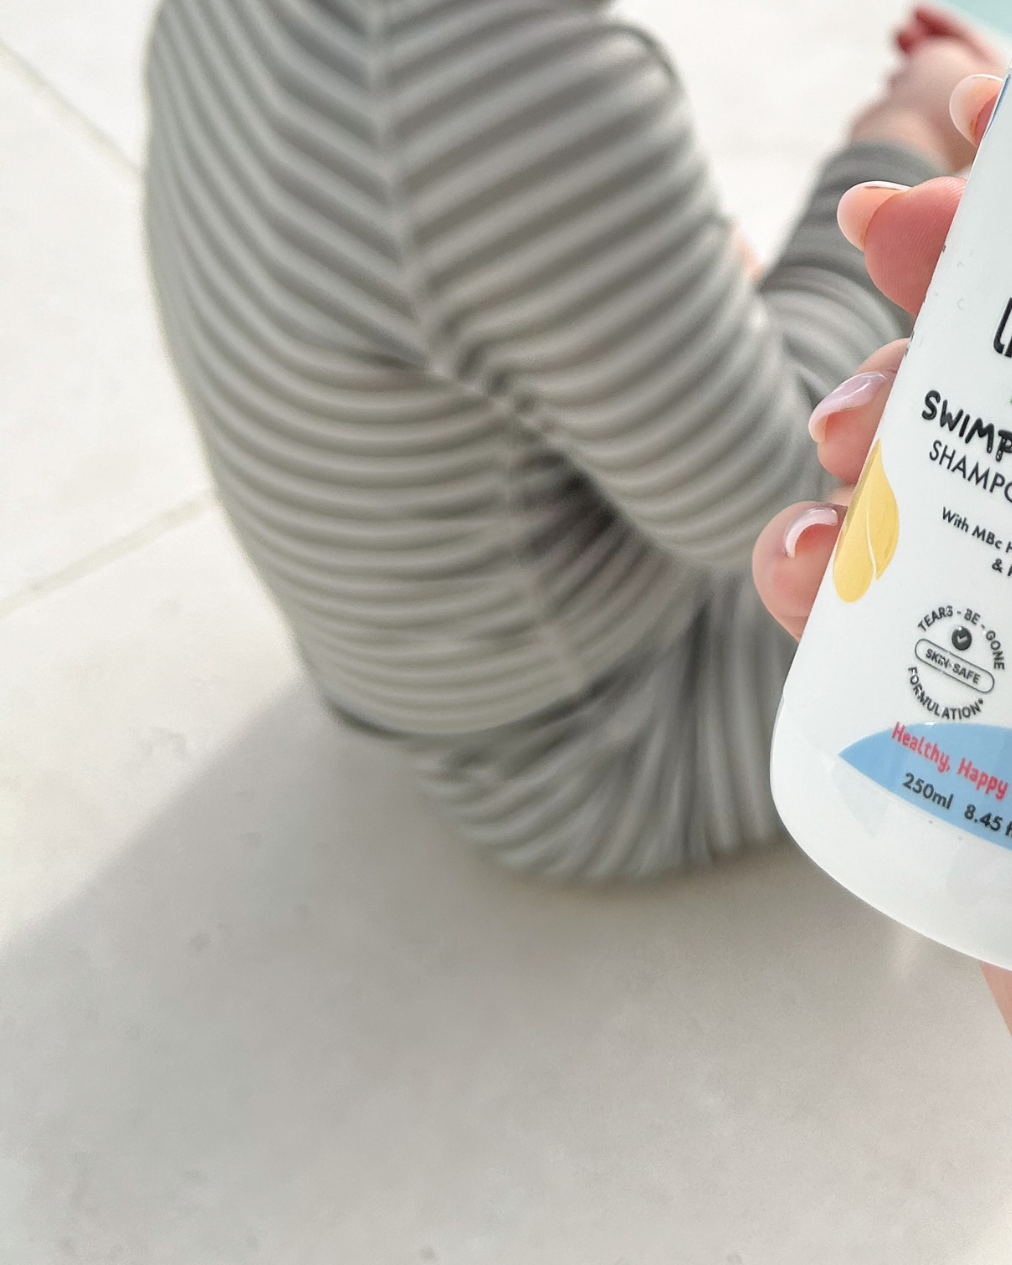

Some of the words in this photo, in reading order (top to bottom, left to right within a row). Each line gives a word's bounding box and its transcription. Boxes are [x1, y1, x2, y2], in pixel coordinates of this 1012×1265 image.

[941, 506, 969, 533] With
[991, 558, 1004, 574] &
[917, 605, 954, 632] TEARS
[963, 608, 981, 626] BE
[985, 630, 1005, 670] GONE
[891, 721, 951, 774] Healthy,
[957, 756, 1009, 801] Happy
[902, 772, 955, 810] 250ml
[964, 803, 1004, 832] 8.45
